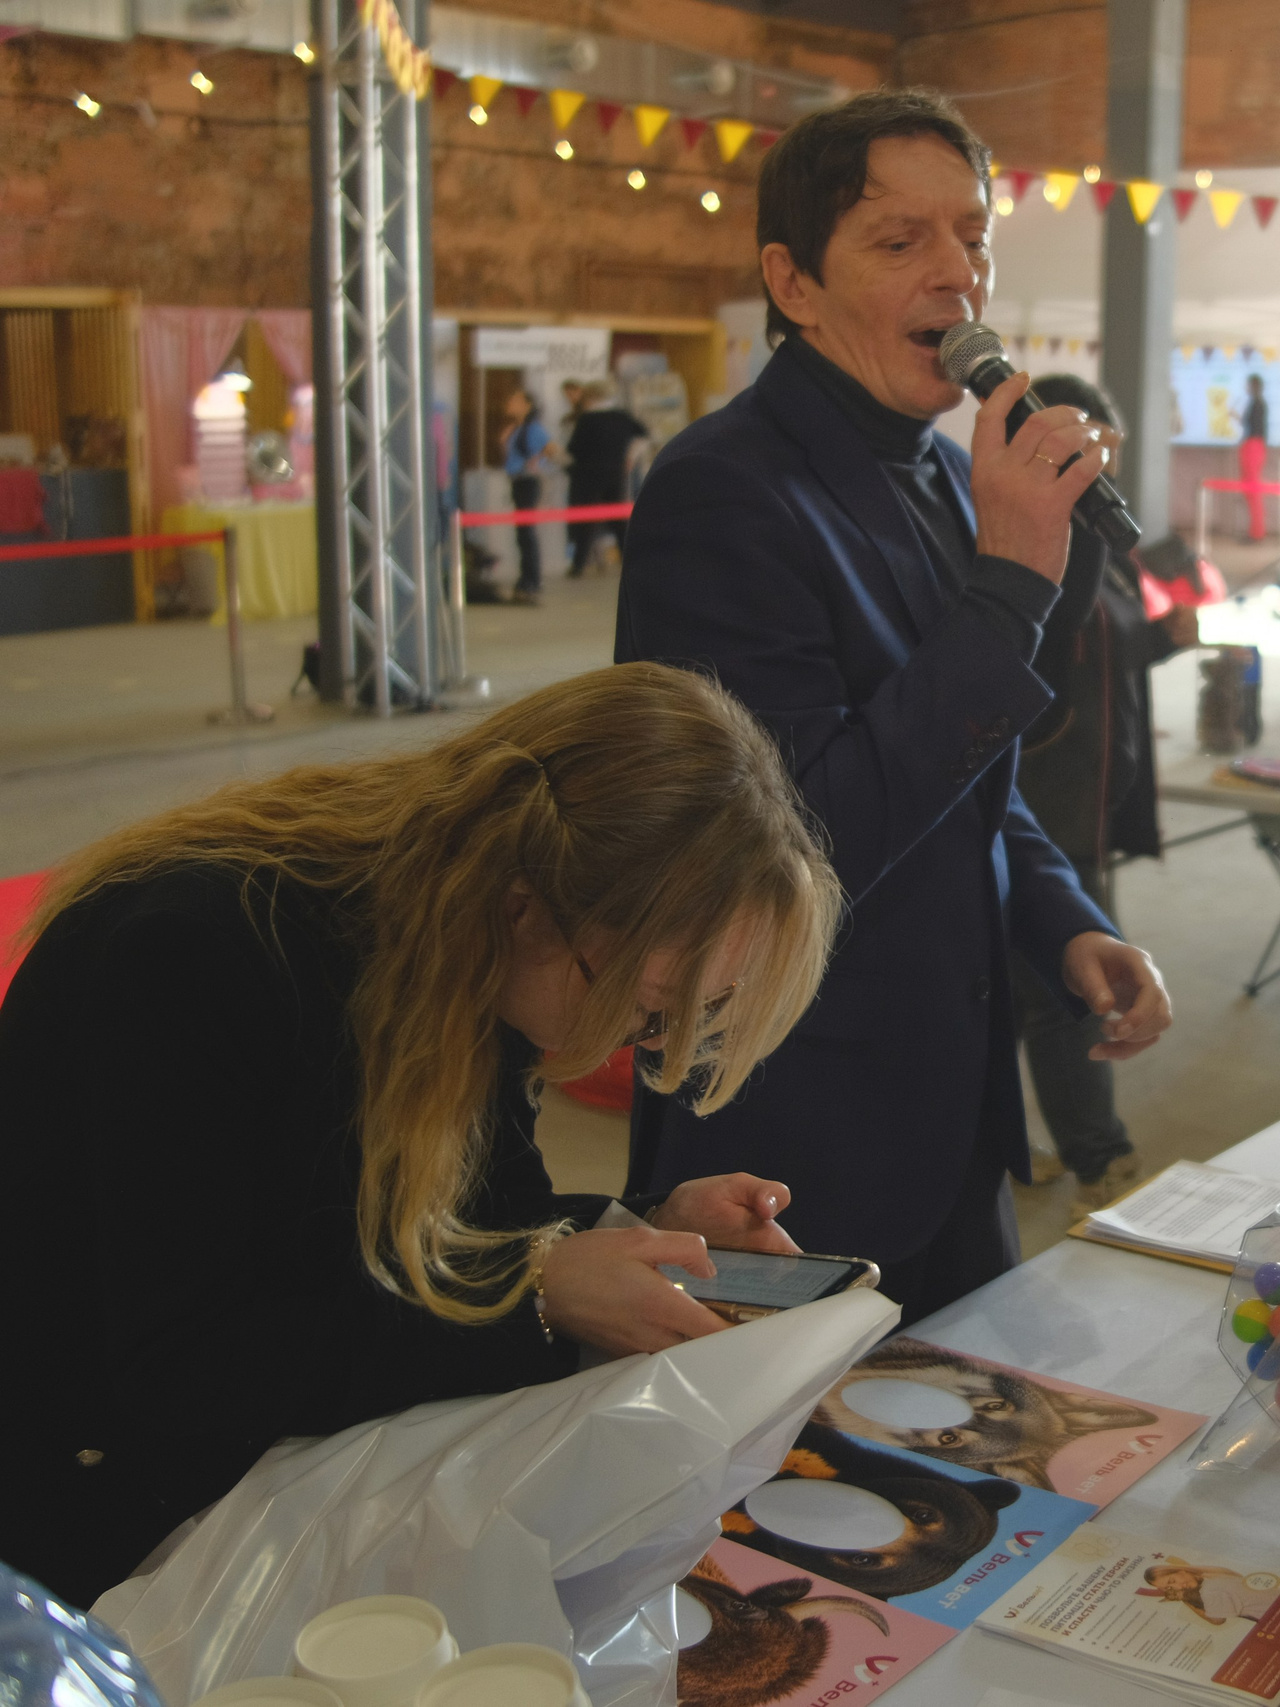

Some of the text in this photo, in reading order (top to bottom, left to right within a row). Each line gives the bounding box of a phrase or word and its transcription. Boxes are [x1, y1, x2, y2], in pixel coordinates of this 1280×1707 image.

[1074, 1449, 1138, 1496] Вельвет
[938, 1551, 1012, 1610] Вельвет
[1039, 1590, 1081, 1630] ПОЗВОЛЬТЕ
[1078, 1564, 1107, 1593] ВАШЕМУ
[1049, 1599, 1086, 1633] ПИТОМЦУ
[1082, 1580, 1106, 1602] СТАТЬ
[1103, 1556, 1130, 1584] ГЕРОЕМ
[1061, 1630, 1073, 1638] И
[1068, 1603, 1098, 1631] СПАСТИ
[1094, 1579, 1121, 1605] ЧЬЮ-ТО
